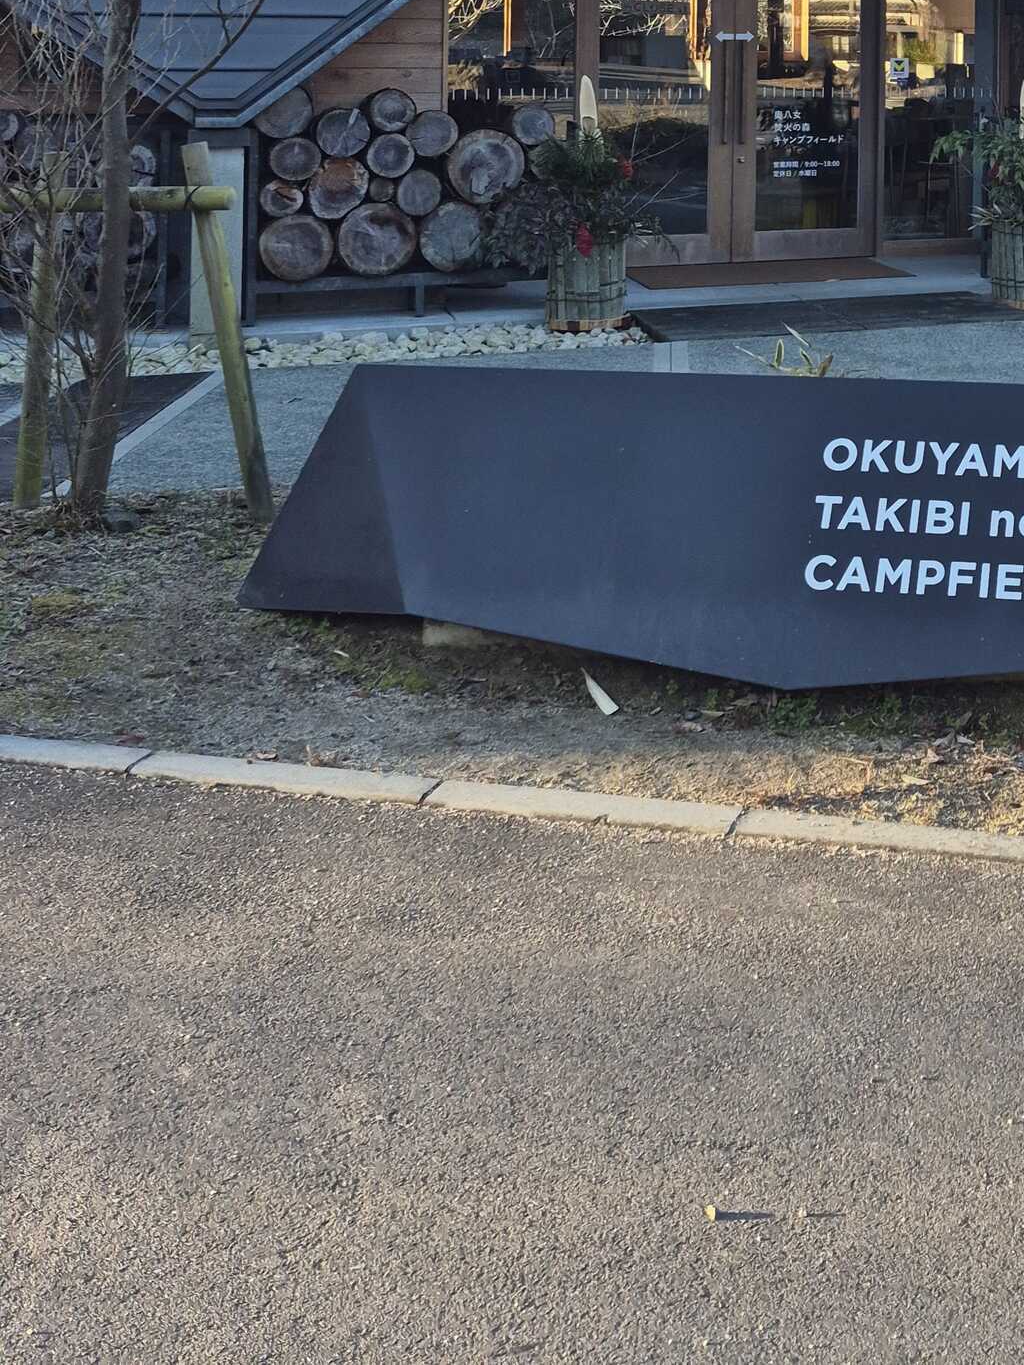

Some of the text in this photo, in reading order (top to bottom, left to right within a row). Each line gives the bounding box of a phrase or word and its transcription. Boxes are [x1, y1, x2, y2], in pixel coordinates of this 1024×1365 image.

[774, 110, 801, 121] 奥八女
[773, 134, 845, 147] キャンプフィールド
[815, 494, 971, 536] TAKIBI
